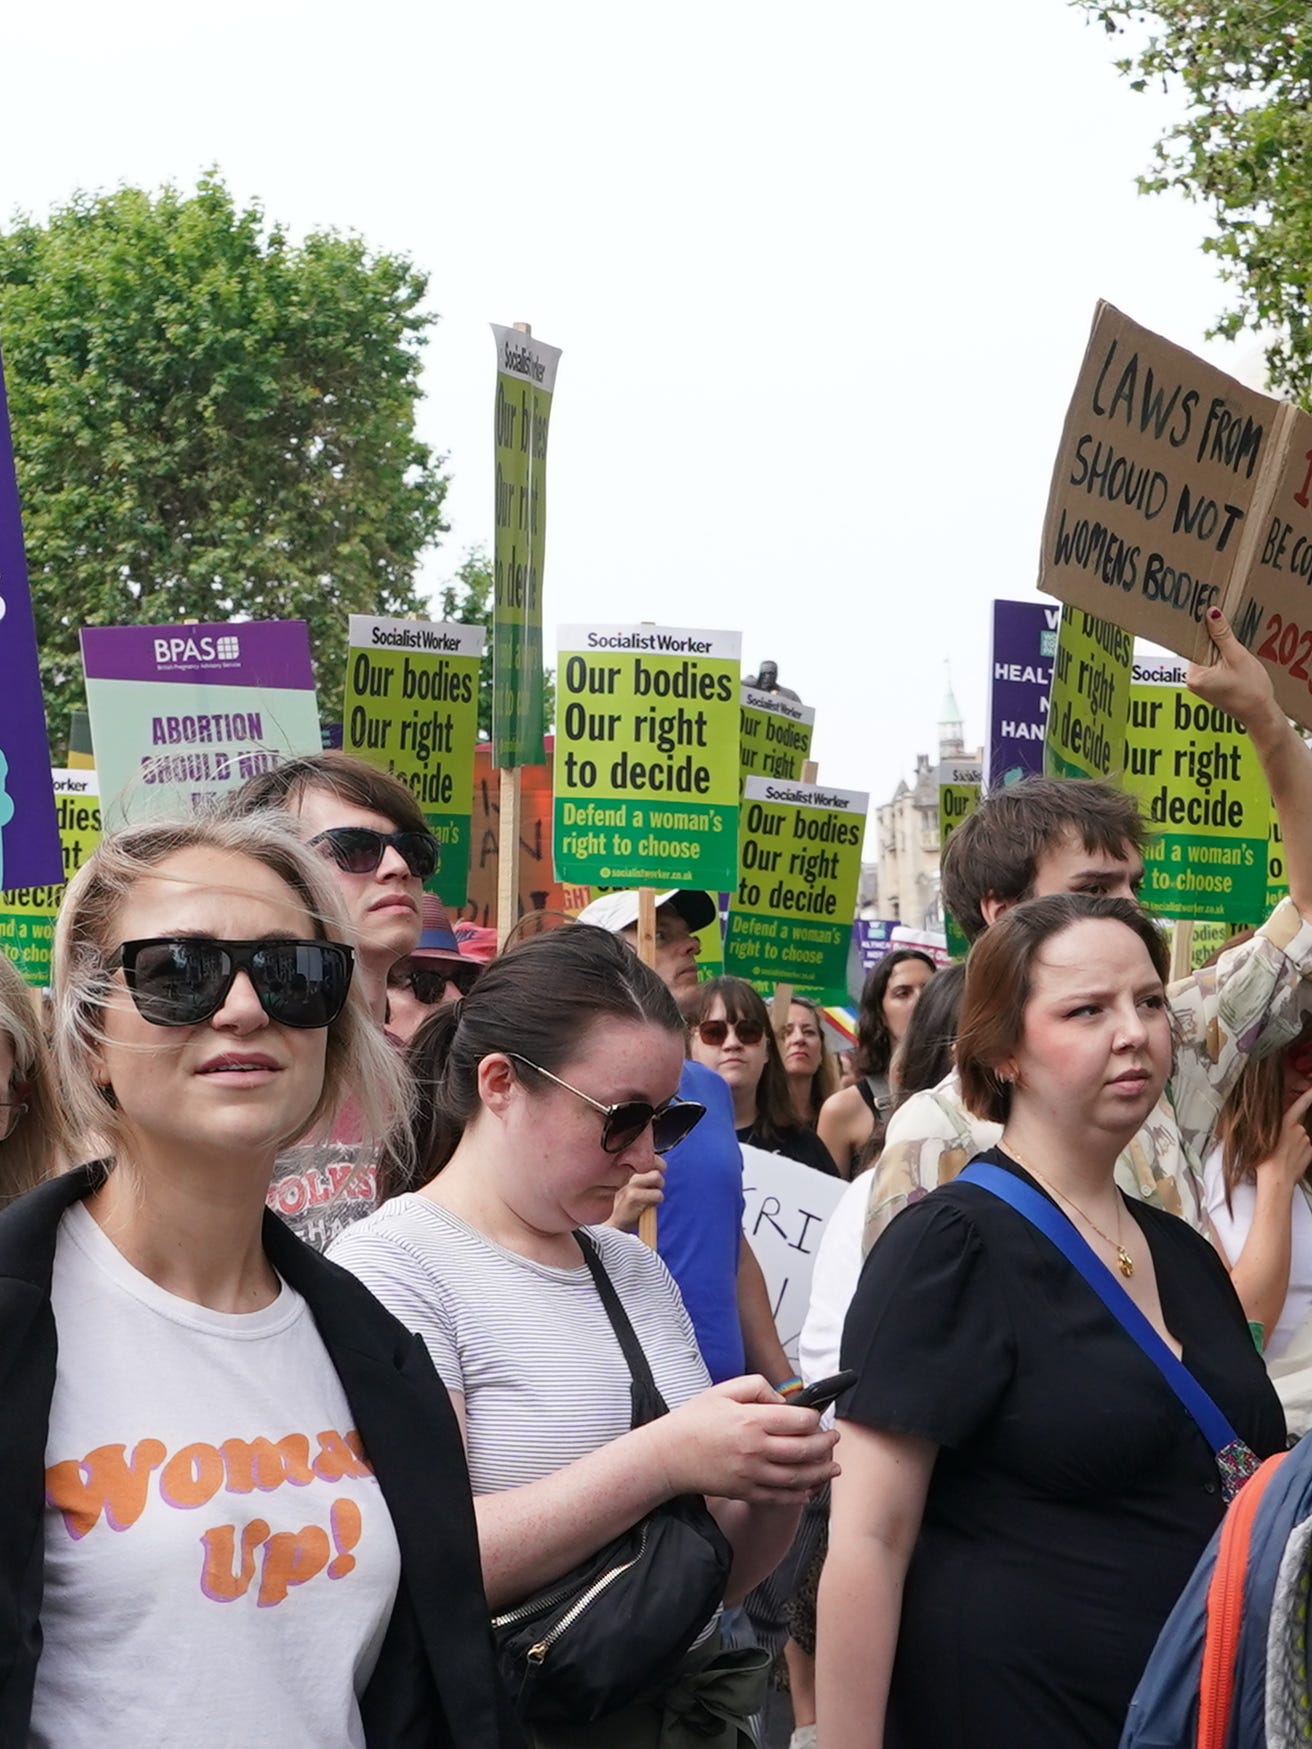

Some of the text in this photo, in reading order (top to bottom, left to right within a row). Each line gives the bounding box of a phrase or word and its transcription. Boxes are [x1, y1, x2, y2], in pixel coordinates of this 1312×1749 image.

[1092, 338, 1264, 480] LAWS FROM
[1172, 484, 1244, 552] NOT
[1054, 508, 1141, 593] WOMENS
[1261, 517, 1292, 572] BE
[154, 637, 216, 663] BPAS
[372, 626, 461, 651] Socialist Worker
[588, 632, 712, 654] Socialist Worker
[353, 653, 473, 703] Our bodies
[566, 656, 621, 695] Our
[634, 658, 732, 702] bodies
[994, 663, 1054, 685] HEAL
[1078, 652, 1115, 718] right
[152, 712, 264, 745] ABORTION
[565, 702, 707, 753] Our right
[1126, 695, 1163, 728] ur
[350, 705, 454, 762] Our right
[766, 716, 809, 752] bodies
[1061, 701, 1112, 774] decide
[141, 750, 280, 785] SHOULD NOT
[565, 751, 711, 795] to decide
[739, 741, 795, 779] ur right
[1174, 740, 1242, 788] right
[766, 786, 850, 809] Socialist Worker
[1151, 785, 1244, 828] decide
[563, 803, 723, 833] Defend a woman's
[746, 804, 860, 846] Our bodies
[562, 832, 606, 860] right
[612, 834, 631, 855] to
[638, 835, 700, 859] choose
[742, 840, 839, 883] Our right
[1171, 844, 1182, 862] a
[1188, 843, 1255, 866] woman's
[739, 878, 837, 916] to decide
[1151, 868, 1233, 892] to choose
[19, 923, 28, 938] a
[732, 915, 841, 945] Defend a woman's
[4, 943, 19, 961] to
[729, 938, 823, 964] right to choose
